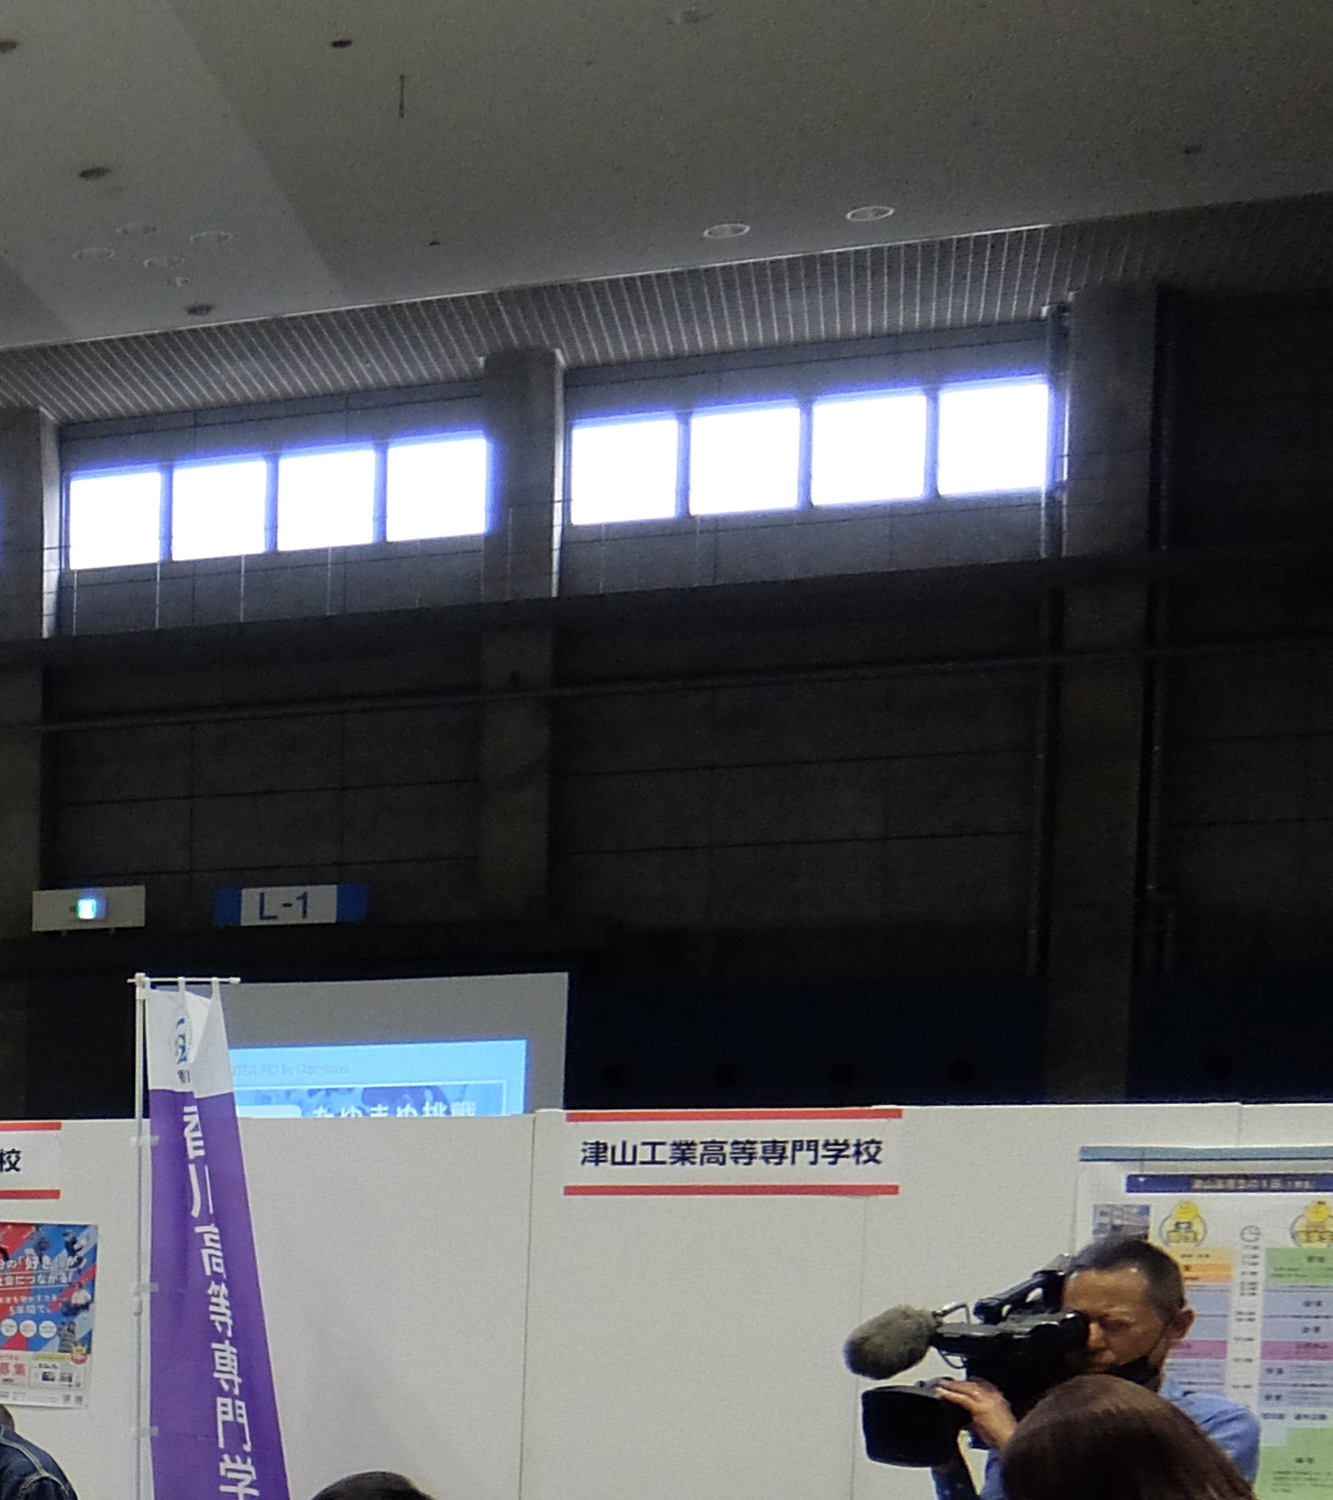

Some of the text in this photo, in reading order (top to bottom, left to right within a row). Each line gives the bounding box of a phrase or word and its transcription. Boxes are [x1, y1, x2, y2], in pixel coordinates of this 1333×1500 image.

[259, 891, 308, 921] L-1
[580, 1138, 883, 1167] 津山工業高等専門学校
